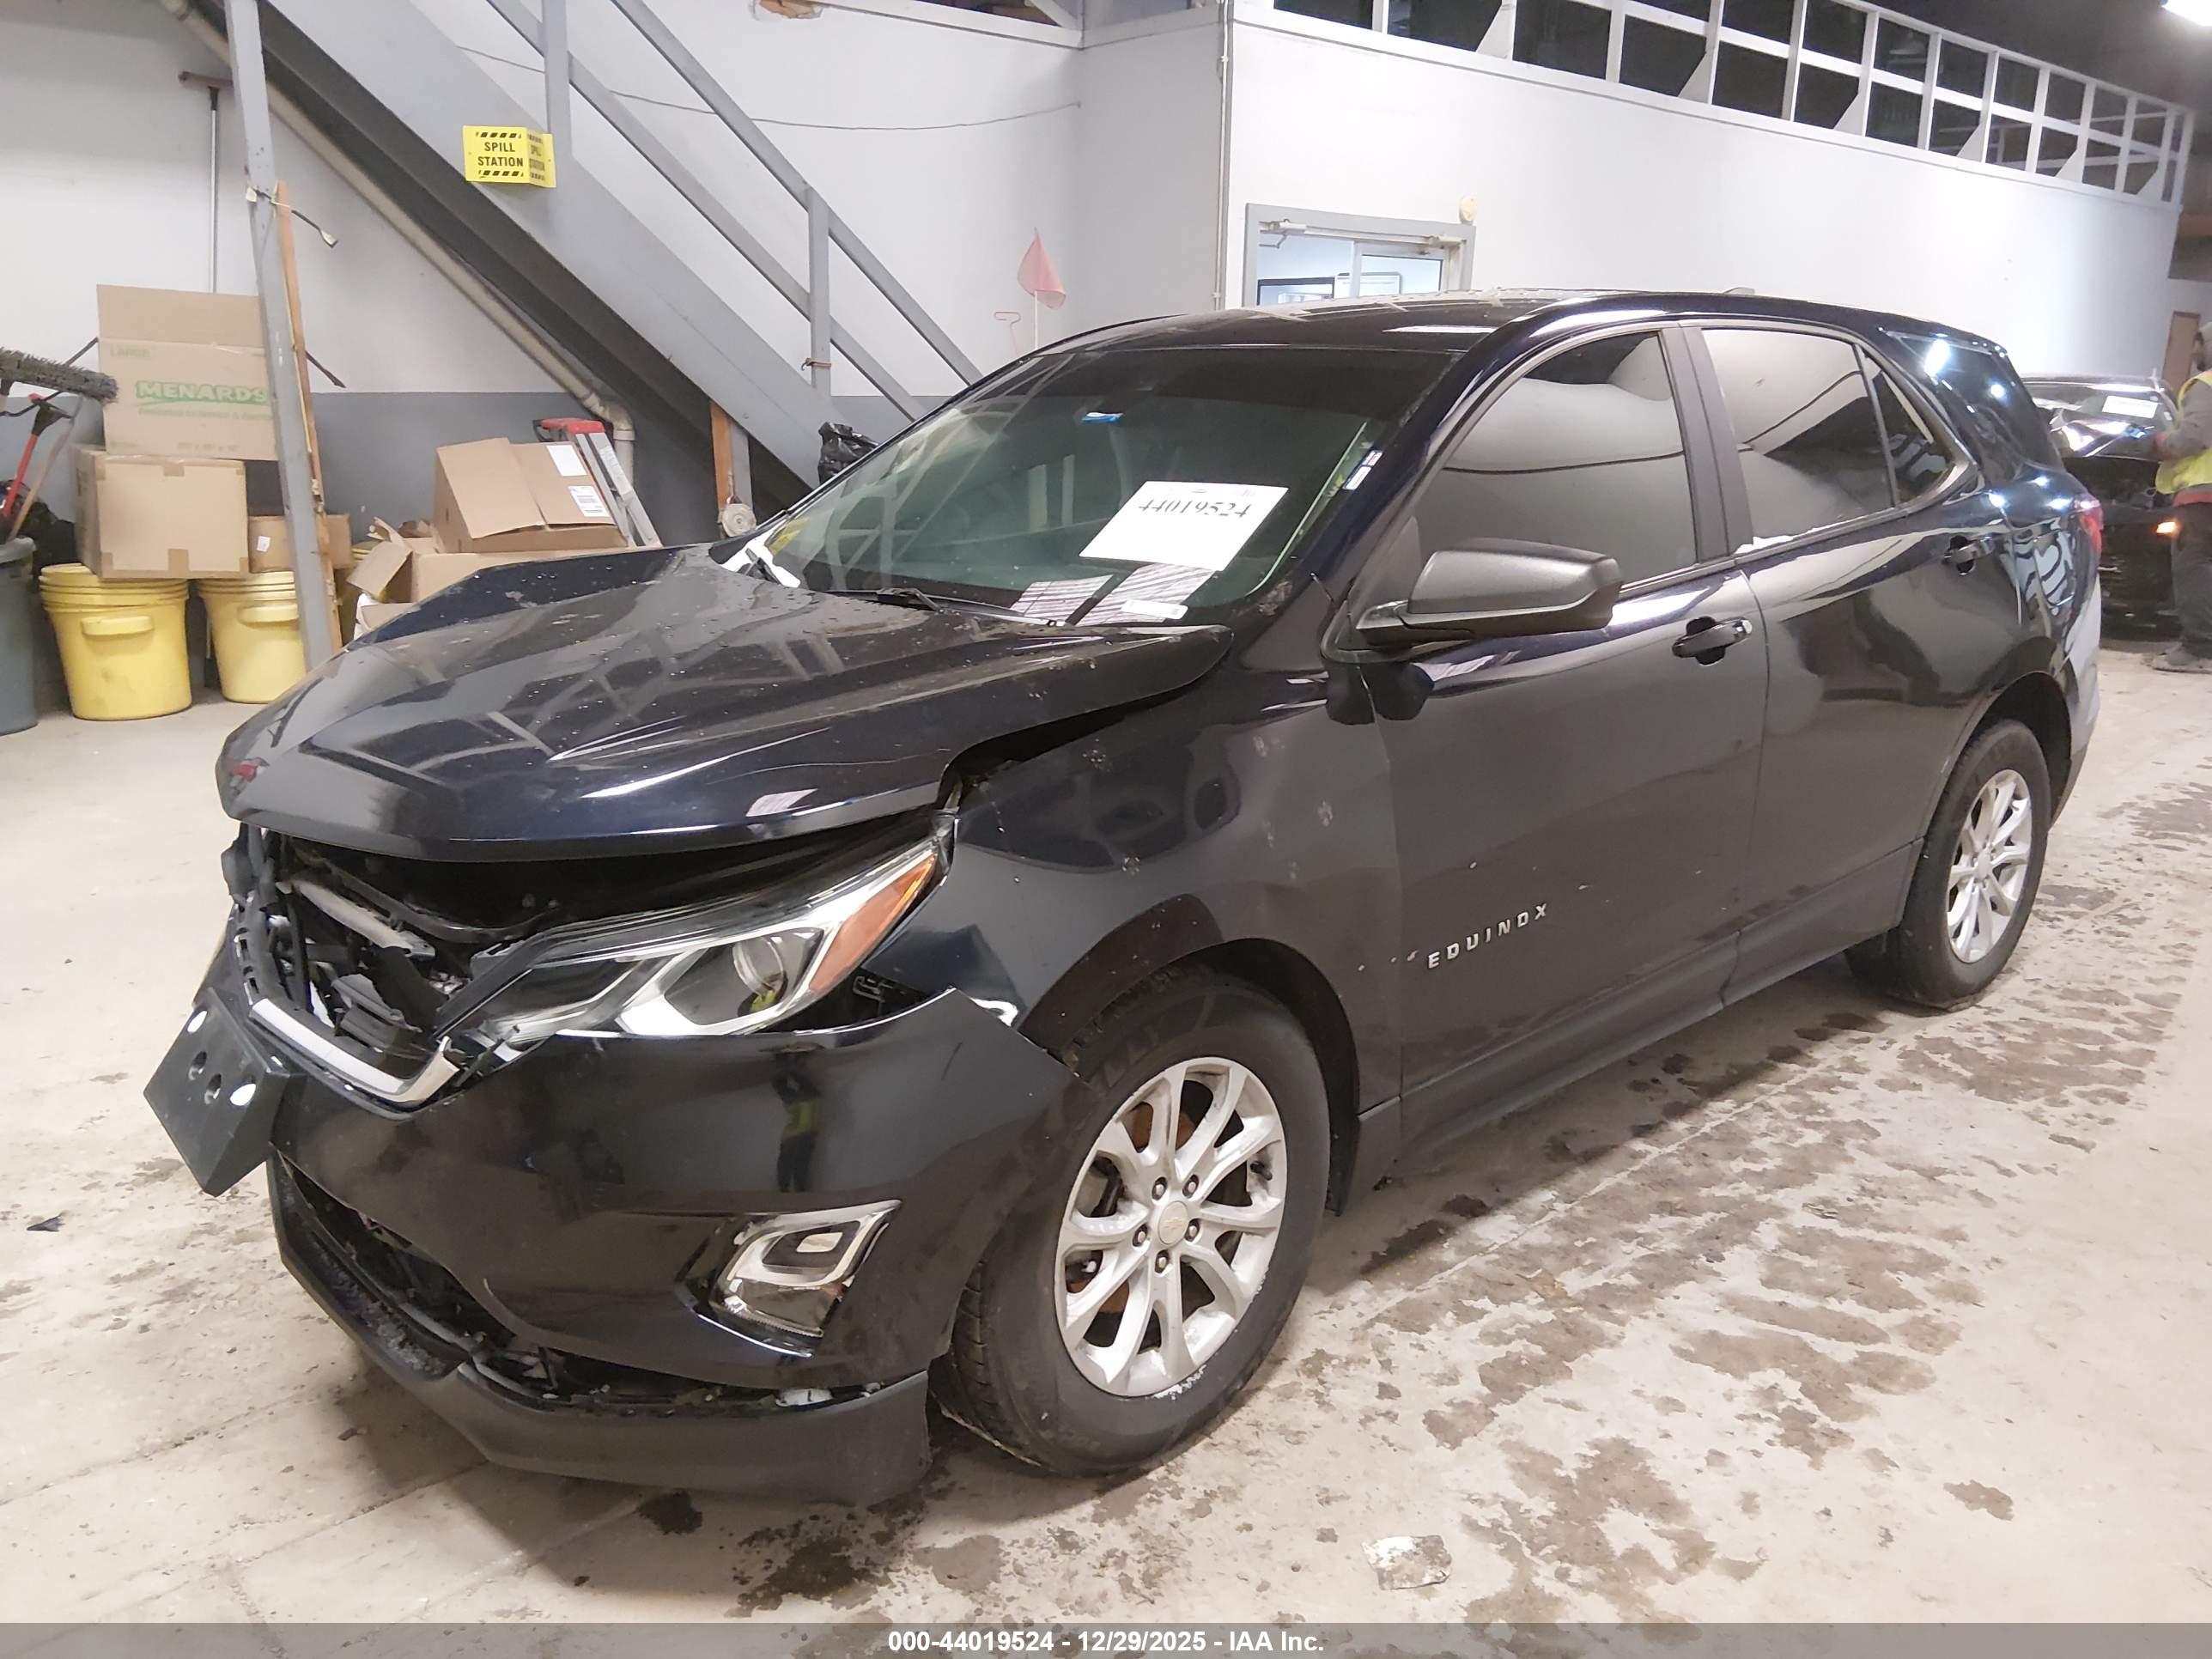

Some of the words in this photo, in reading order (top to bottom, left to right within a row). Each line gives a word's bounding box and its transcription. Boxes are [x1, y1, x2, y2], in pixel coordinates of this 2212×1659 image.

[483, 142, 516, 153] SPILL
[477, 155, 524, 167] STATION
[135, 380, 269, 404] MENARDS
[1138, 499, 1253, 518] 44019524
[1427, 902, 1547, 969] EQUINOX
